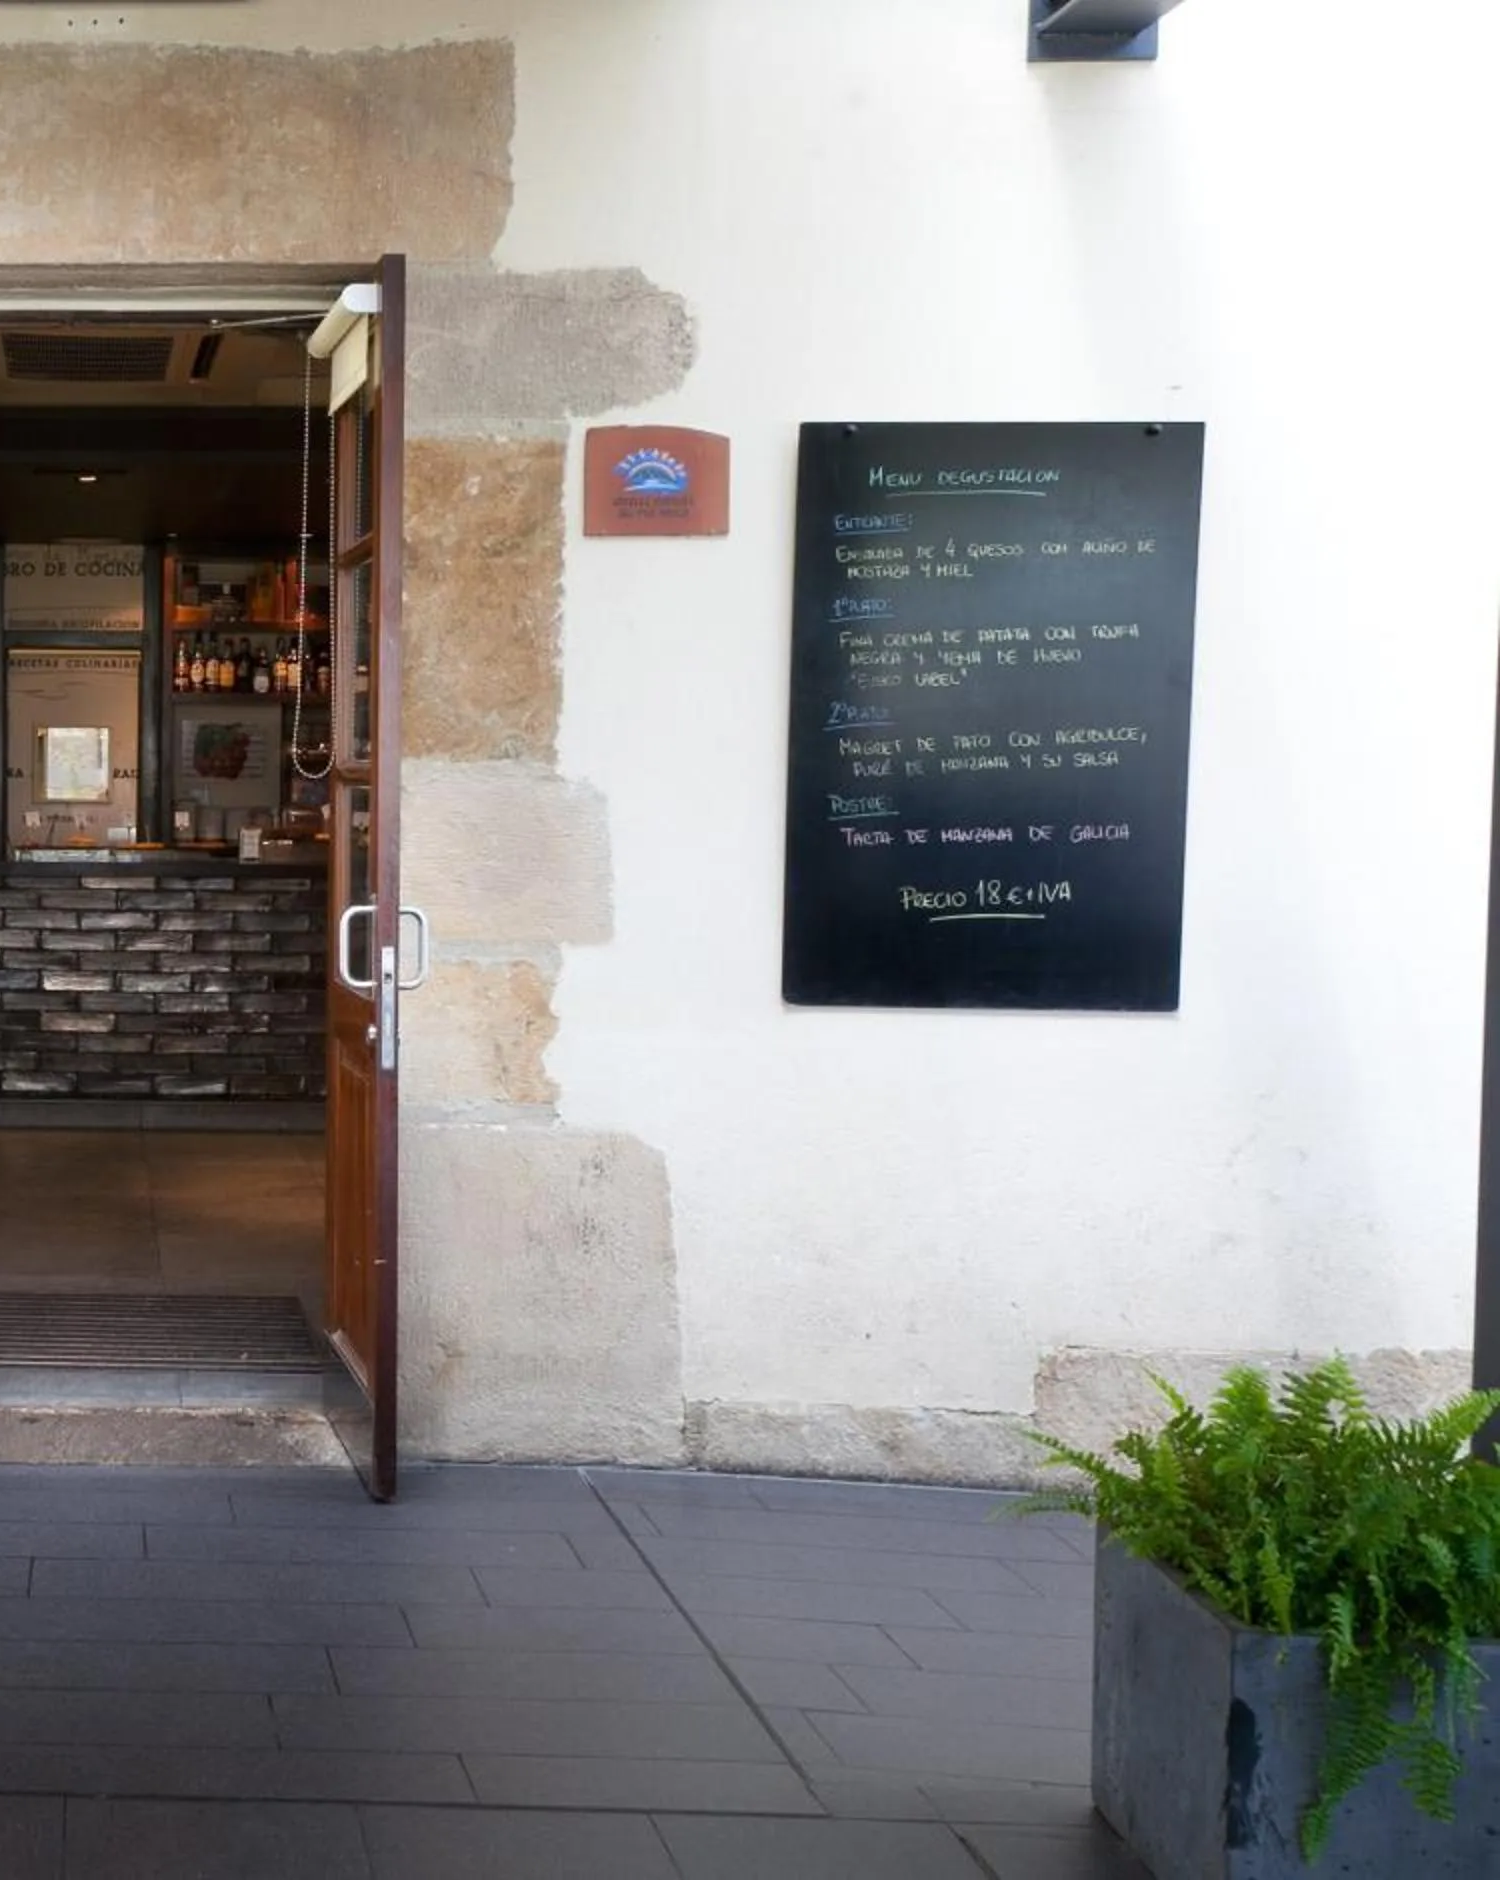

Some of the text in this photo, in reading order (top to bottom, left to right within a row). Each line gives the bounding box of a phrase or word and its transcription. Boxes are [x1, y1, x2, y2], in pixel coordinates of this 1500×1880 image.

[868, 466, 923, 488] MENU
[43, 561, 67, 577] DE
[935, 563, 974, 578] MIEL
[906, 828, 928, 844] DE
[1028, 825, 1055, 840] DE
[899, 885, 968, 912] PRECIO
